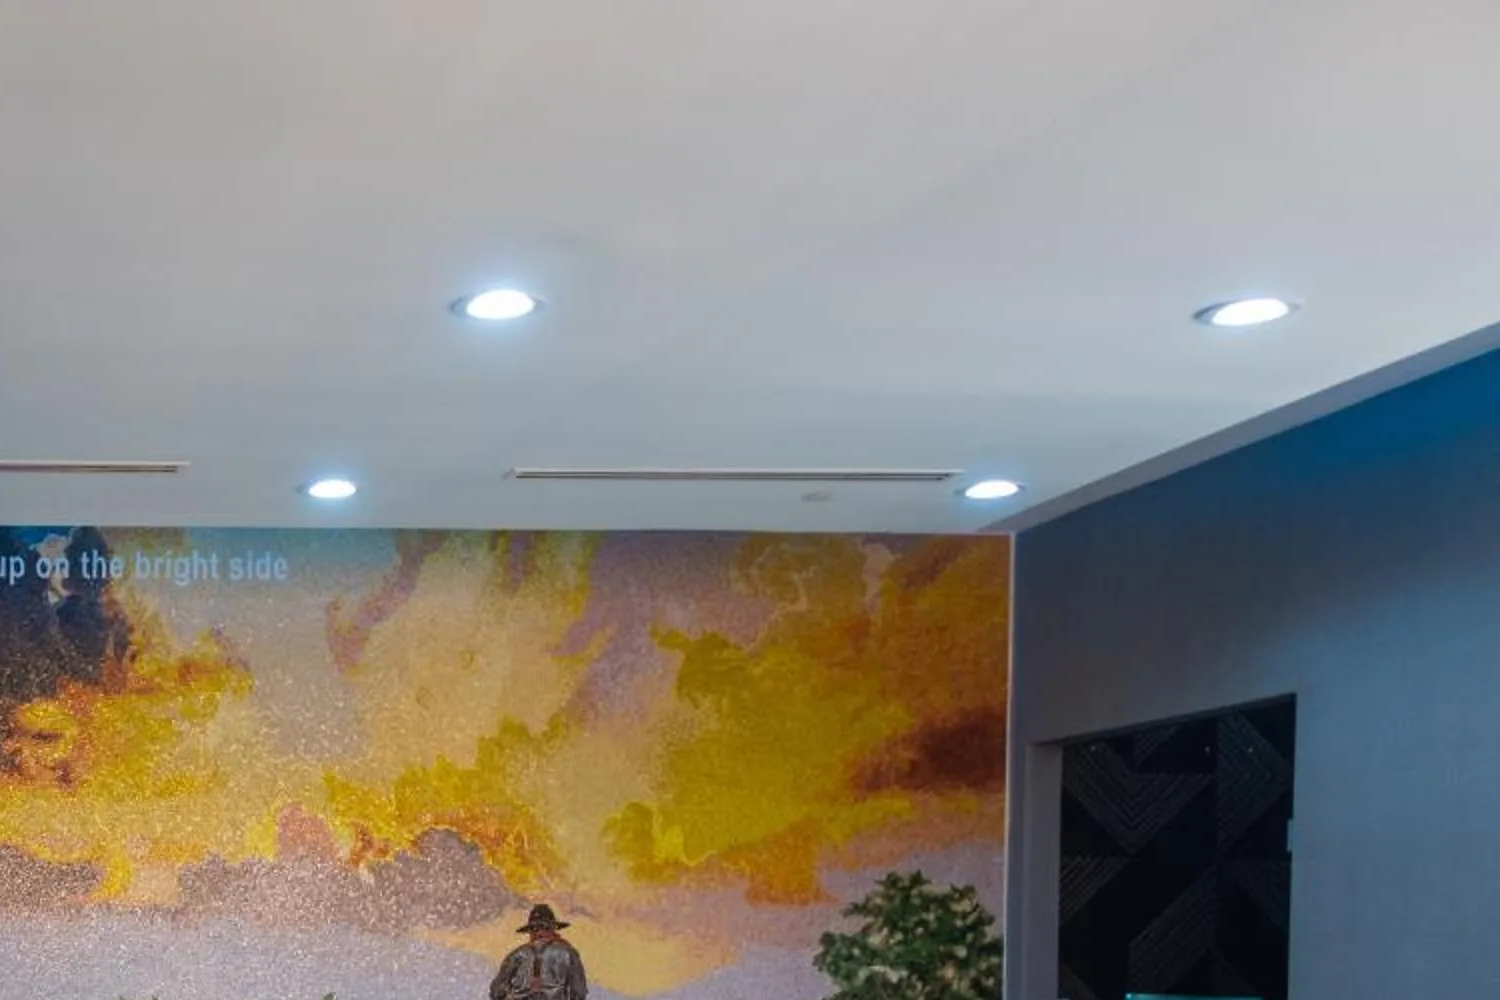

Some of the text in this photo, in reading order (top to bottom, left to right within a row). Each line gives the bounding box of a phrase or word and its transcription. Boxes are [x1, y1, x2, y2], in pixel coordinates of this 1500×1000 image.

[35, 556, 71, 578] on
[80, 550, 124, 579] the
[135, 550, 220, 586] bright
[229, 550, 289, 581] side
